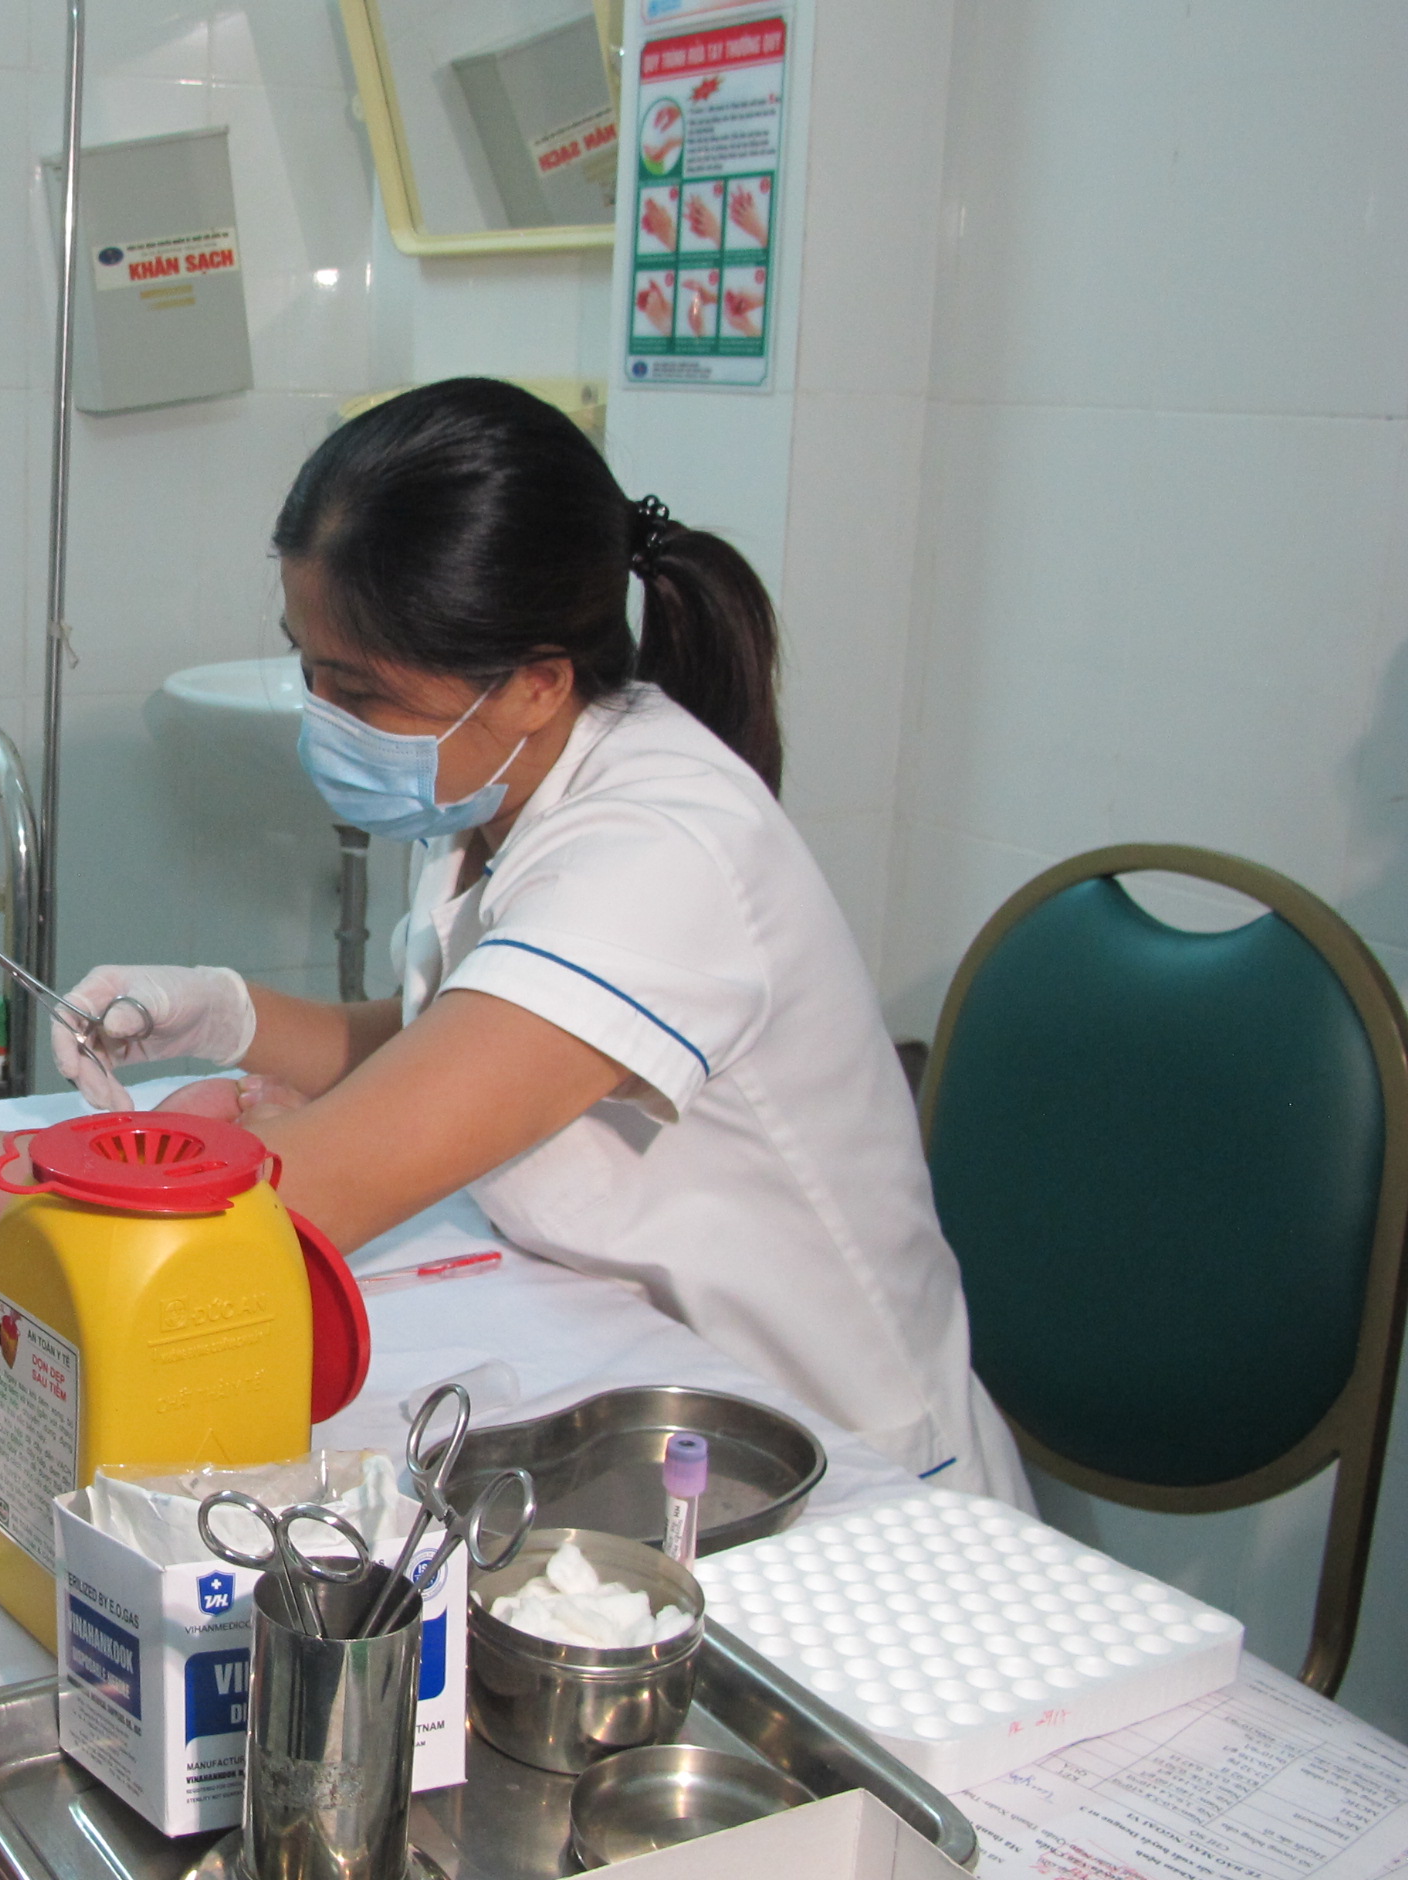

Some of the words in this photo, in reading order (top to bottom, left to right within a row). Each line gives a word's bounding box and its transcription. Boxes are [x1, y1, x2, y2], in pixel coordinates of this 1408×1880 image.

[129, 256, 180, 281] KHĂN
[186, 249, 234, 275] SẠCH
[28, 1329, 37, 1343] AN
[57, 1350, 62, 1360] Y
[32, 1369, 49, 1388] SAU
[67, 1571, 97, 1602] ERILIZED
[98, 1591, 108, 1609] BY
[230, 1702, 247, 1725] DI
[186, 1754, 245, 1772] MANUFACTUR
[415, 1720, 445, 1734] TNAM
